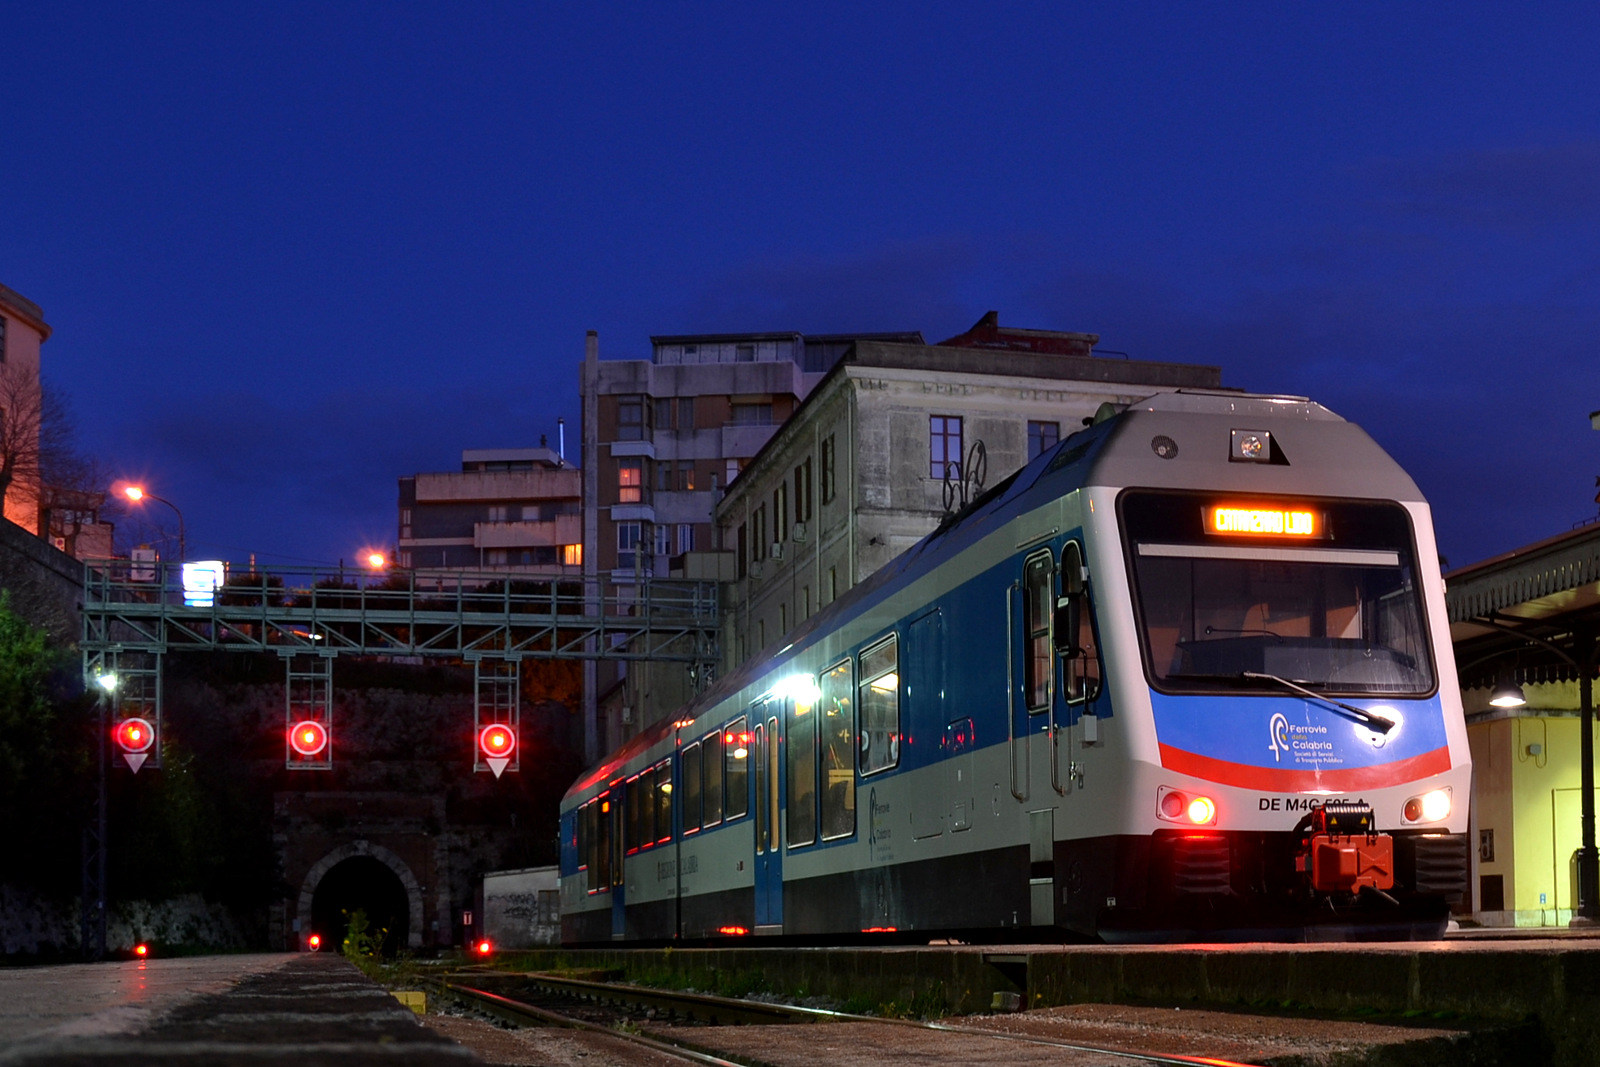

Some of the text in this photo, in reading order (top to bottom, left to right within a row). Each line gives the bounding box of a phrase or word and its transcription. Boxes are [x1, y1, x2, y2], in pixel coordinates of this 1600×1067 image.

[1290, 724, 1328, 734] Ferrovie
[1292, 740, 1333, 750] Calabria
[1259, 798, 1281, 811] DE
